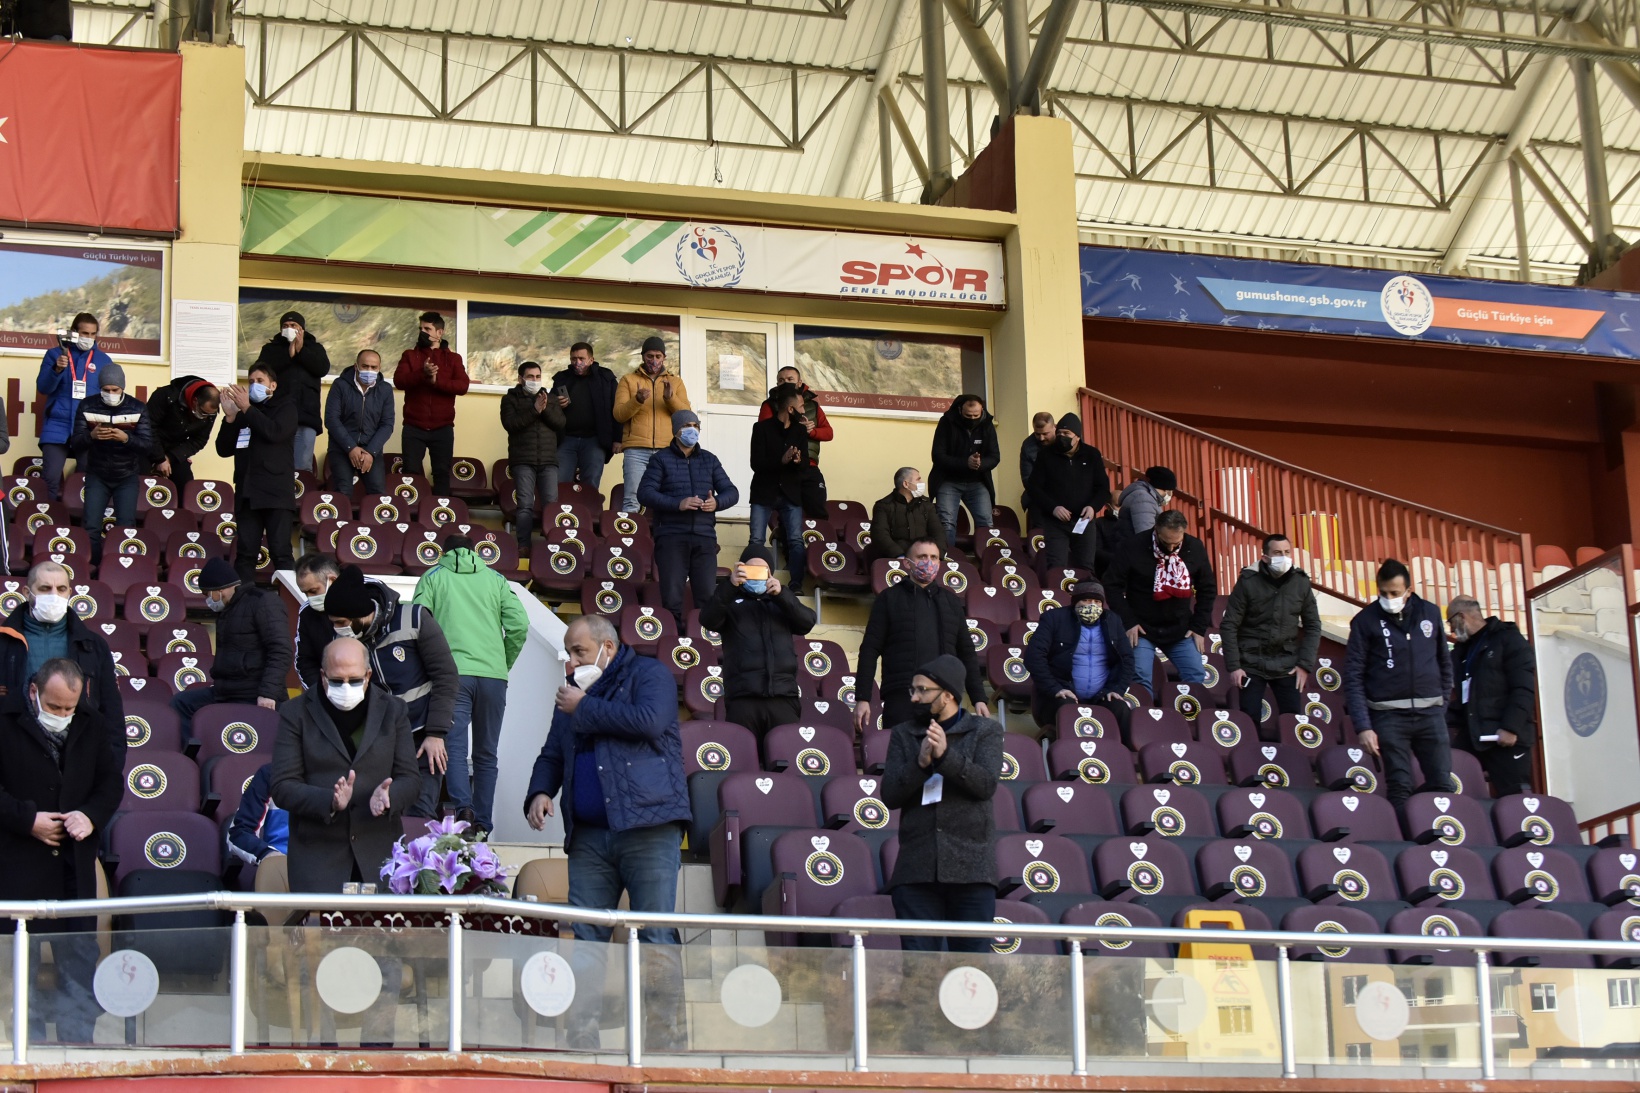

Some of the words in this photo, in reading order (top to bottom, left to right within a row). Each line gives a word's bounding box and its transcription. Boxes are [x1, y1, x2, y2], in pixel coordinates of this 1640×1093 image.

[83, 252, 107, 261] Güçlü
[109, 254, 139, 262] Türkiye
[723, 264, 736, 272] SPOR
[840, 260, 989, 292] SPOR
[840, 286, 888, 295] GENEL
[895, 289, 988, 301] MÜDÜRLÜĞÜ
[1236, 290, 1367, 309] gumushane.gsb.gov.tr
[1457, 307, 1489, 321] Güçlü
[1491, 310, 1532, 325] Türkiye
[1533, 314, 1554, 327] için
[20, 335, 47, 346] Yayın
[825, 394, 840, 402] Ses
[842, 396, 865, 404] Yayın
[878, 397, 893, 406] Ses
[895, 398, 918, 407] Yayın
[931, 400, 946, 409] Ses
